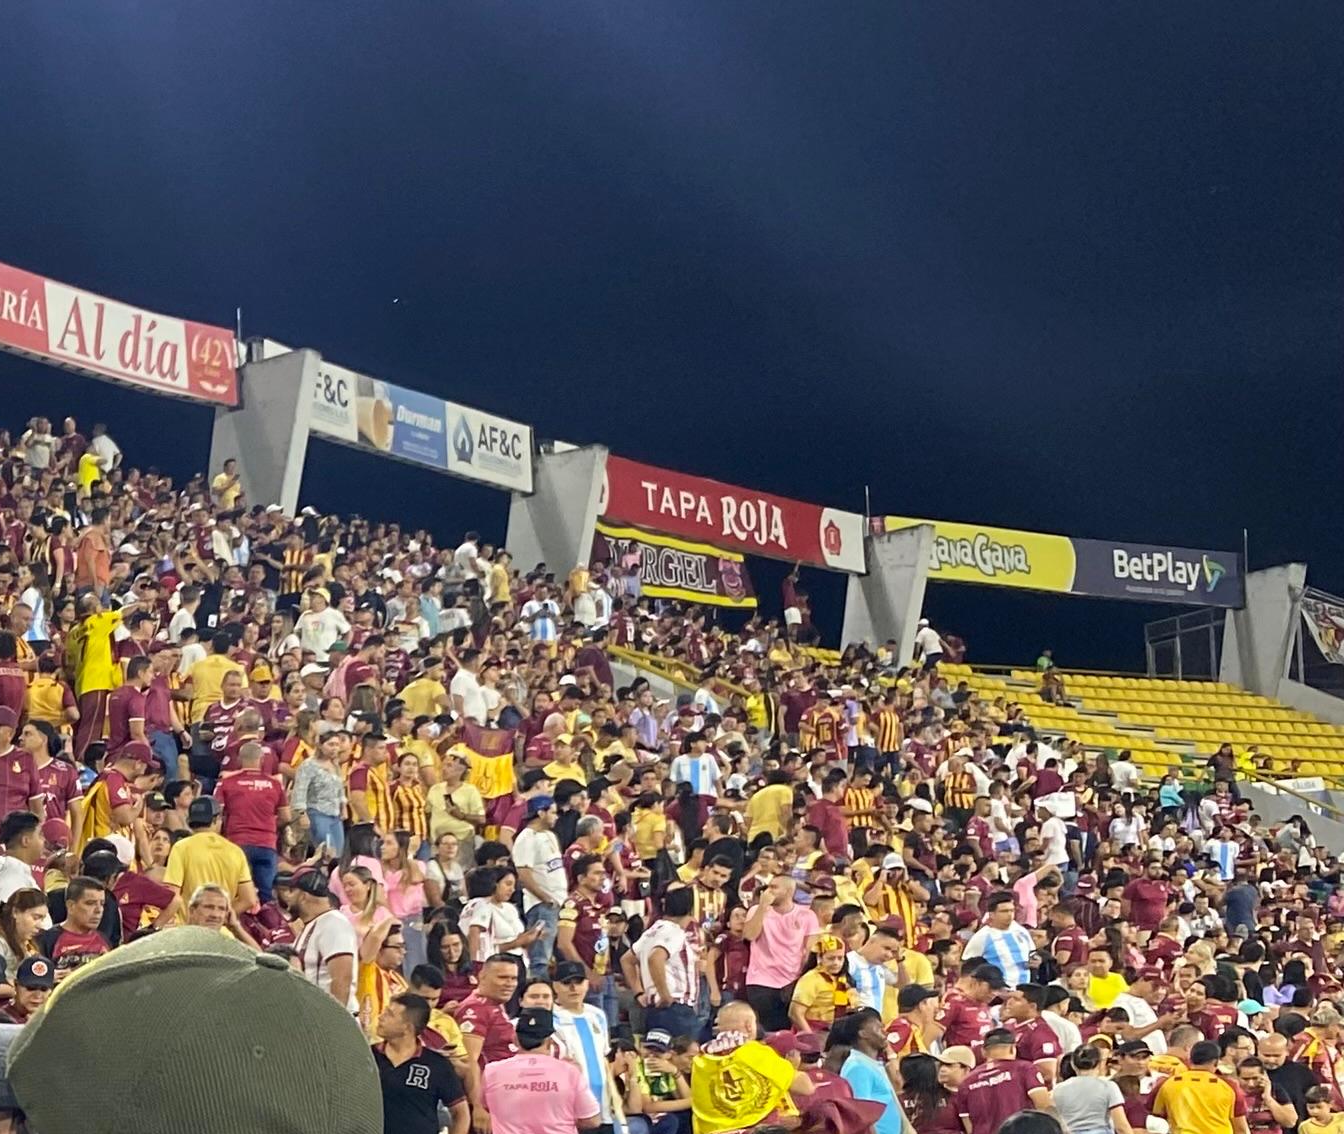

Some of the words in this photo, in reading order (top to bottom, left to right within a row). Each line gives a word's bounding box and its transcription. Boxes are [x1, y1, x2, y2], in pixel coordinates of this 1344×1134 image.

[57, 296, 106, 361] Al
[118, 314, 180, 382] día
[477, 423, 522, 461] AF&C
[641, 481, 714, 526] TAPA
[720, 496, 788, 550] ROJA
[1113, 549, 1200, 592] BetPlay
[405, 1064, 431, 1090] R
[503, 1083, 529, 1091] TAPA
[530, 1081, 559, 1093] ROJA
